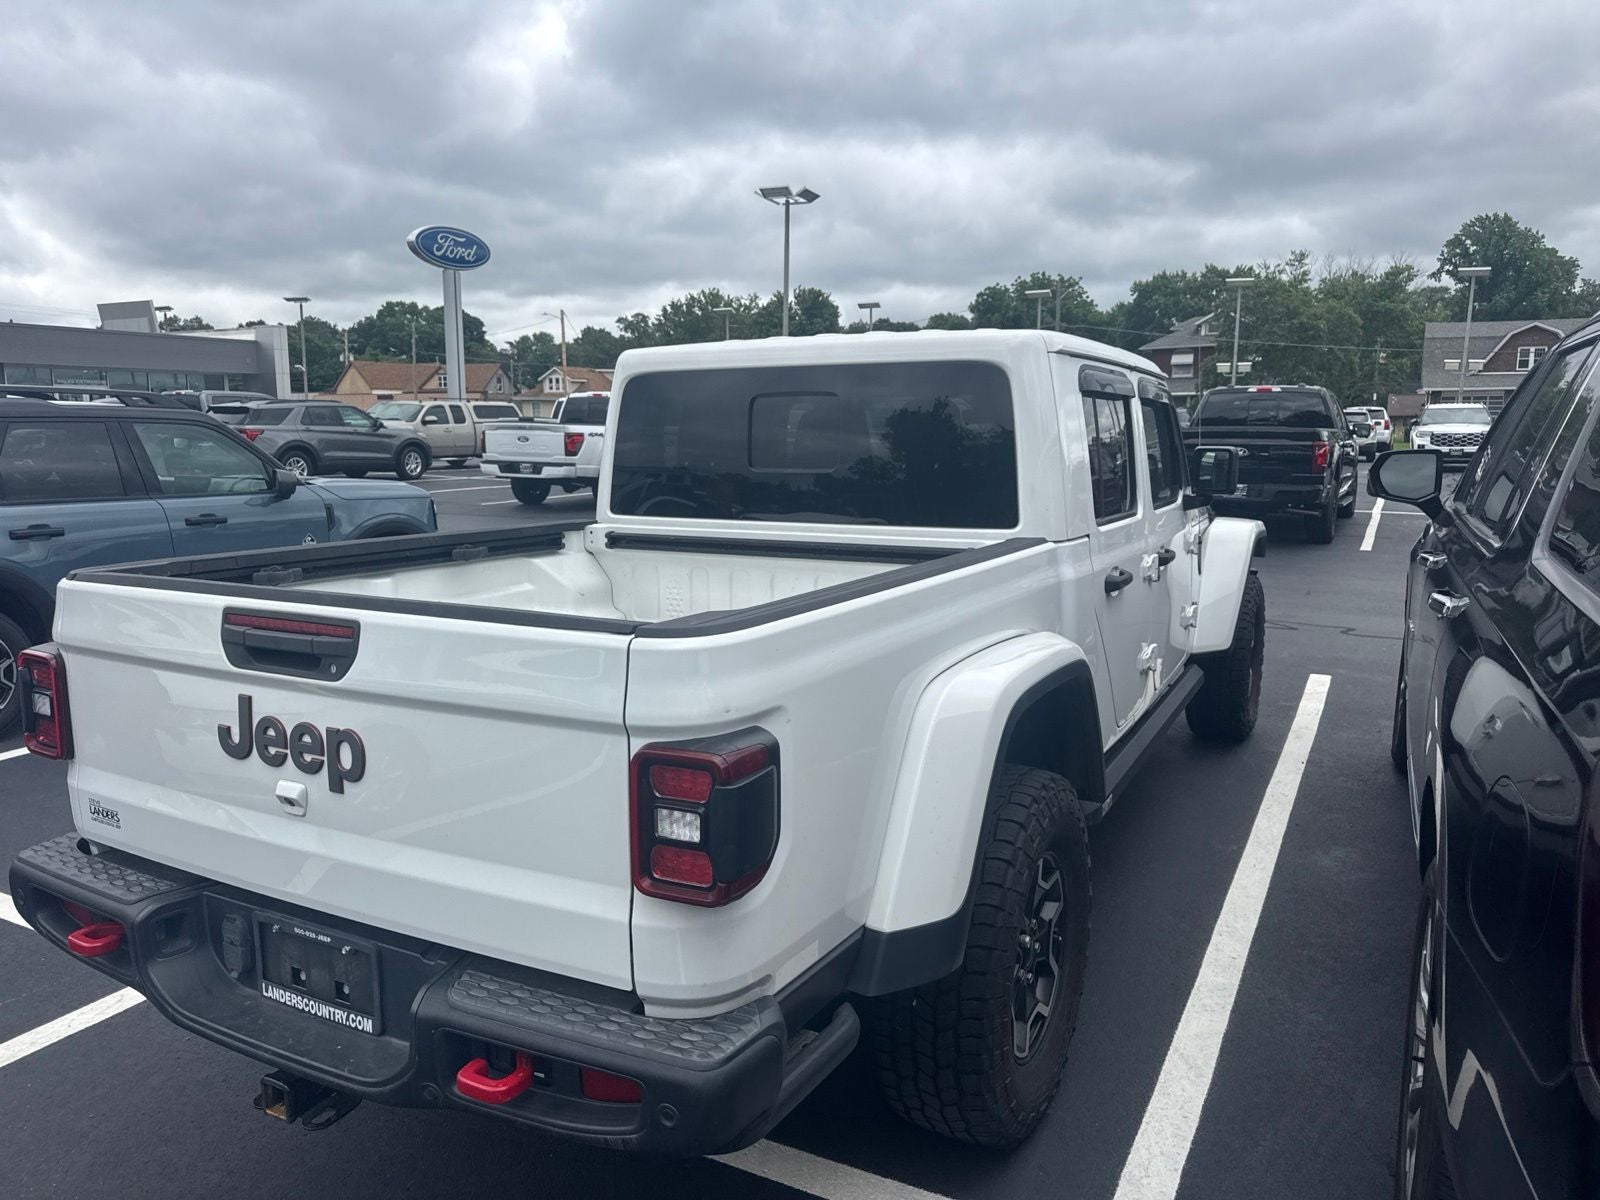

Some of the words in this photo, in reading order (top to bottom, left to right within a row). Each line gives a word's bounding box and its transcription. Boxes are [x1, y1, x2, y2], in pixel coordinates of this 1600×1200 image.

[433, 232, 477, 262] Ford
[217, 693, 366, 795] Jeep
[89, 804, 121, 823] LANDERS
[262, 982, 373, 1034] LANDERSCOUNTRY.COM
